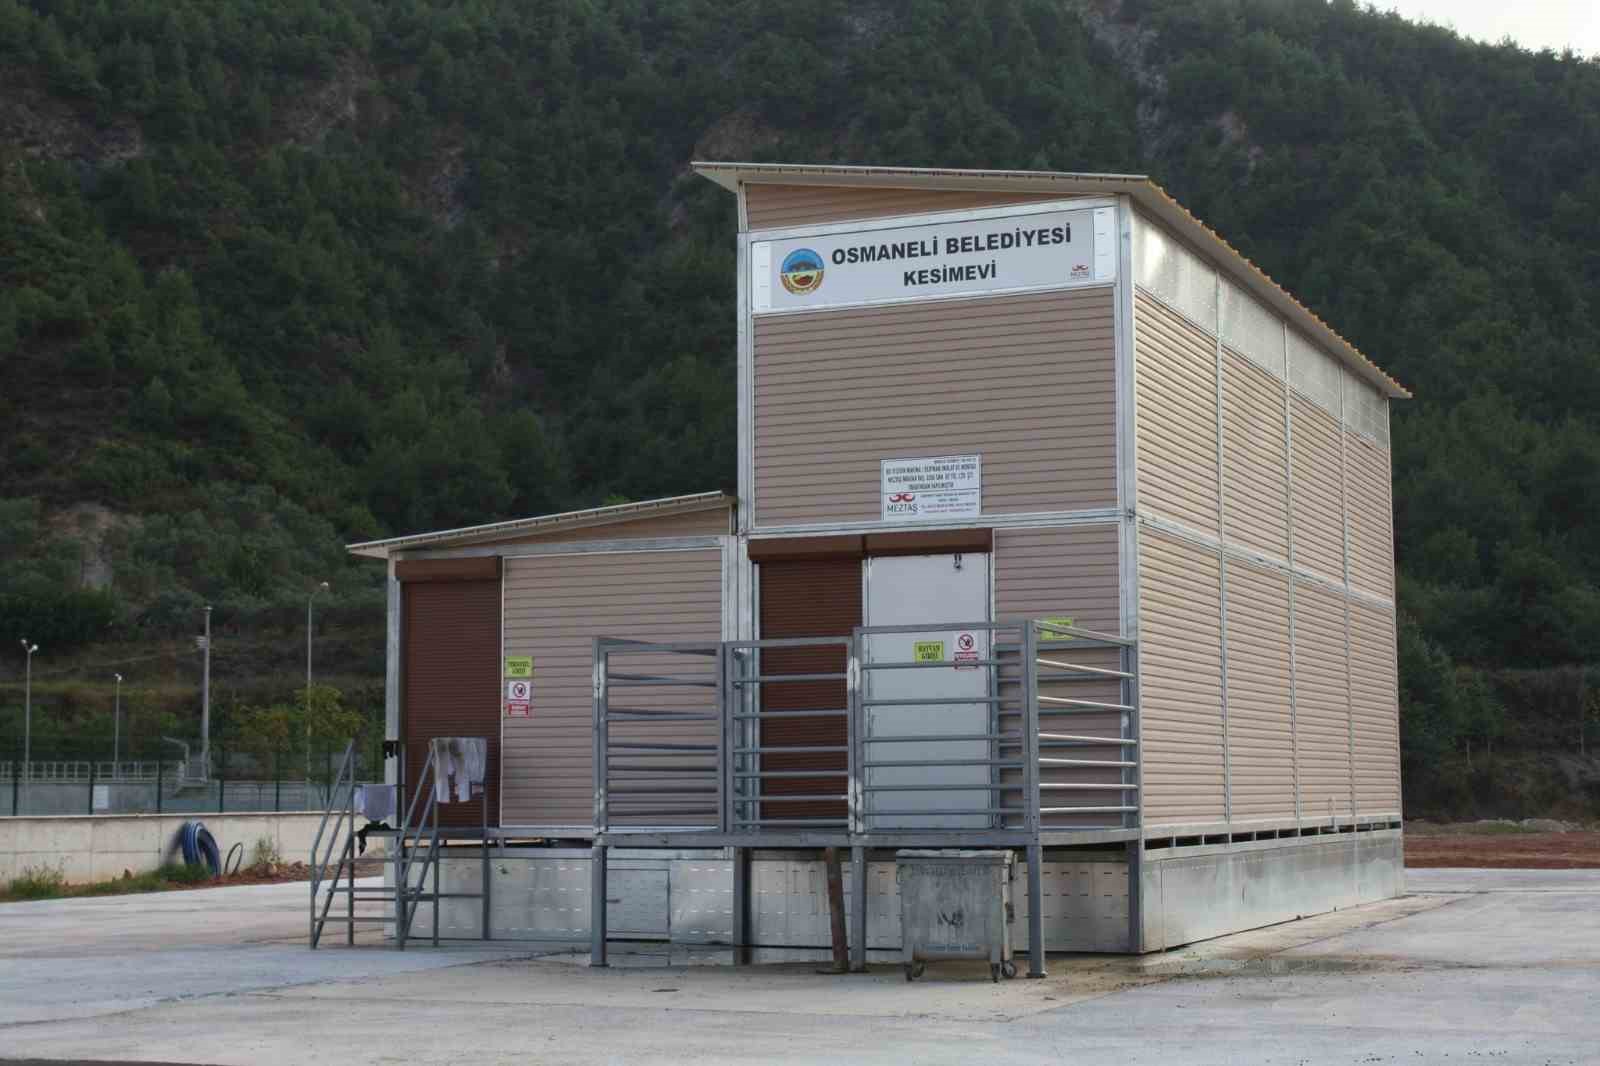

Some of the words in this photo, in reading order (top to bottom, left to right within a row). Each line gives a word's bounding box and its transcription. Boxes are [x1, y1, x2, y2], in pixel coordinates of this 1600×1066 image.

[832, 236, 938, 265] OSMANELİ
[946, 222, 1071, 255] BELEDİYESİ
[903, 259, 996, 287] KESİMEVİ
